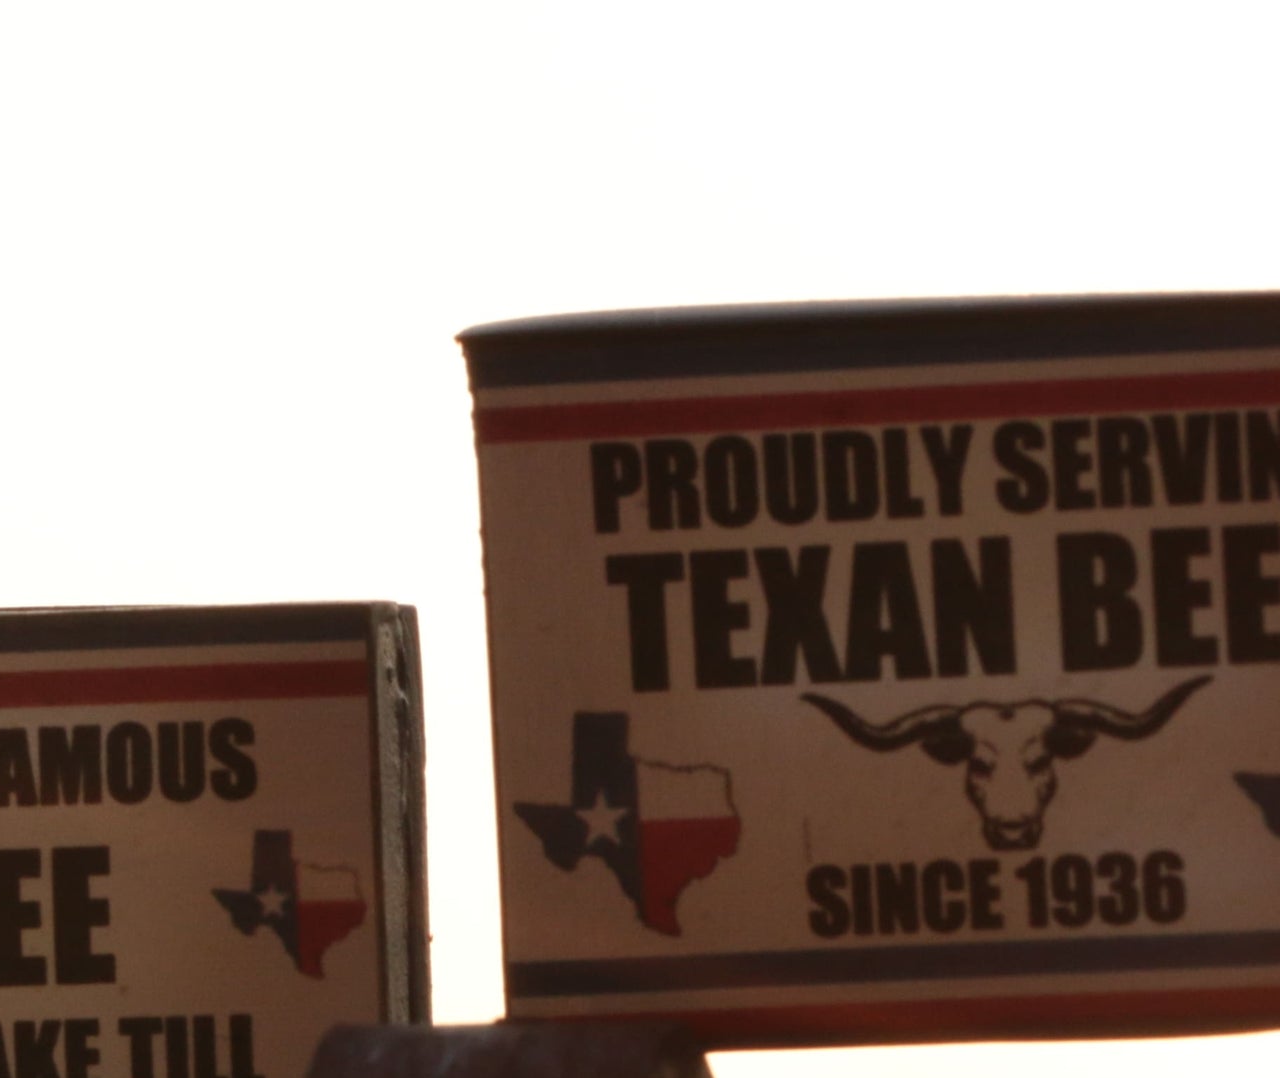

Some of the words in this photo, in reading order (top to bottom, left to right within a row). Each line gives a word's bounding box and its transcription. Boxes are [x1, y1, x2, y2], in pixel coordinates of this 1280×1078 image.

[590, 424, 975, 534] PROUDLY
[605, 534, 1016, 694] TEXAN
[806, 857, 1005, 939] SINCE
[1014, 850, 1186, 930] 1936
